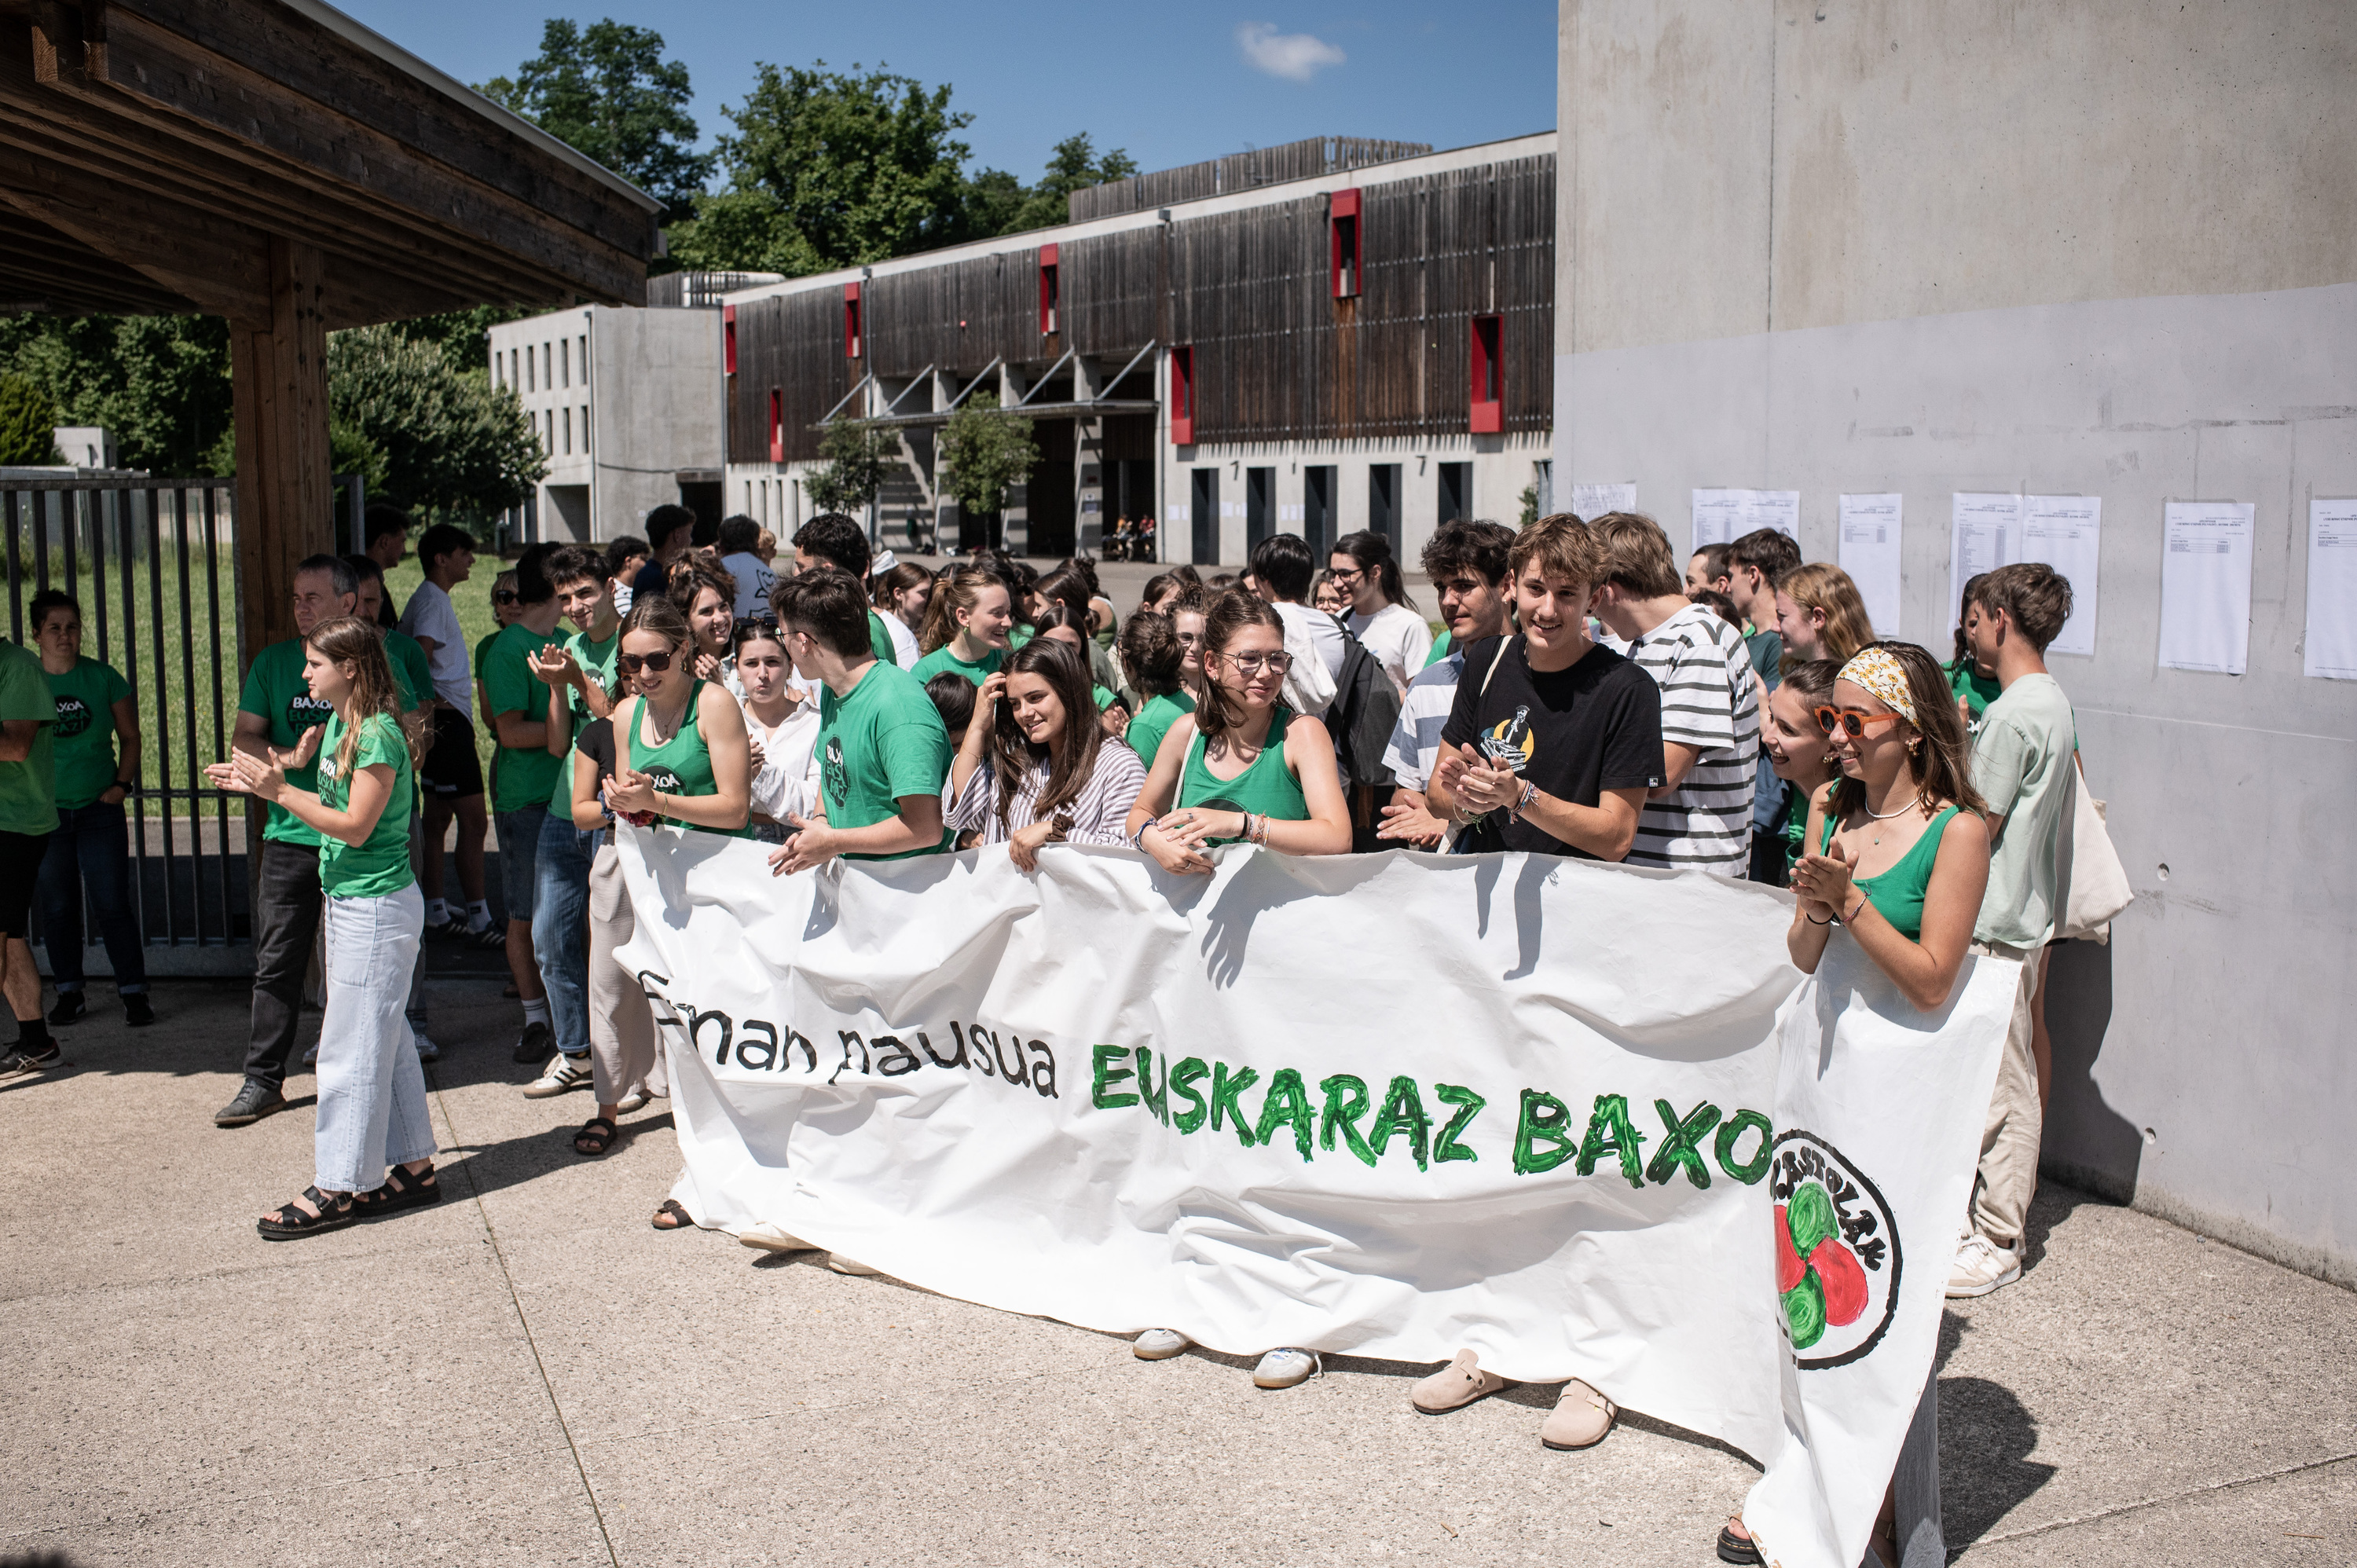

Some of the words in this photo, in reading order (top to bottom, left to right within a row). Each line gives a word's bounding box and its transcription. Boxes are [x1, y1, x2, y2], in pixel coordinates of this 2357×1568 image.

[57, 701, 84, 713] XOA
[293, 697, 333, 710] BAXO
[60, 709, 90, 722] SKA
[289, 709, 331, 722] EUSK
[651, 773, 680, 789] XOA
[1092, 1046, 1486, 1172] EUSKARAZ
